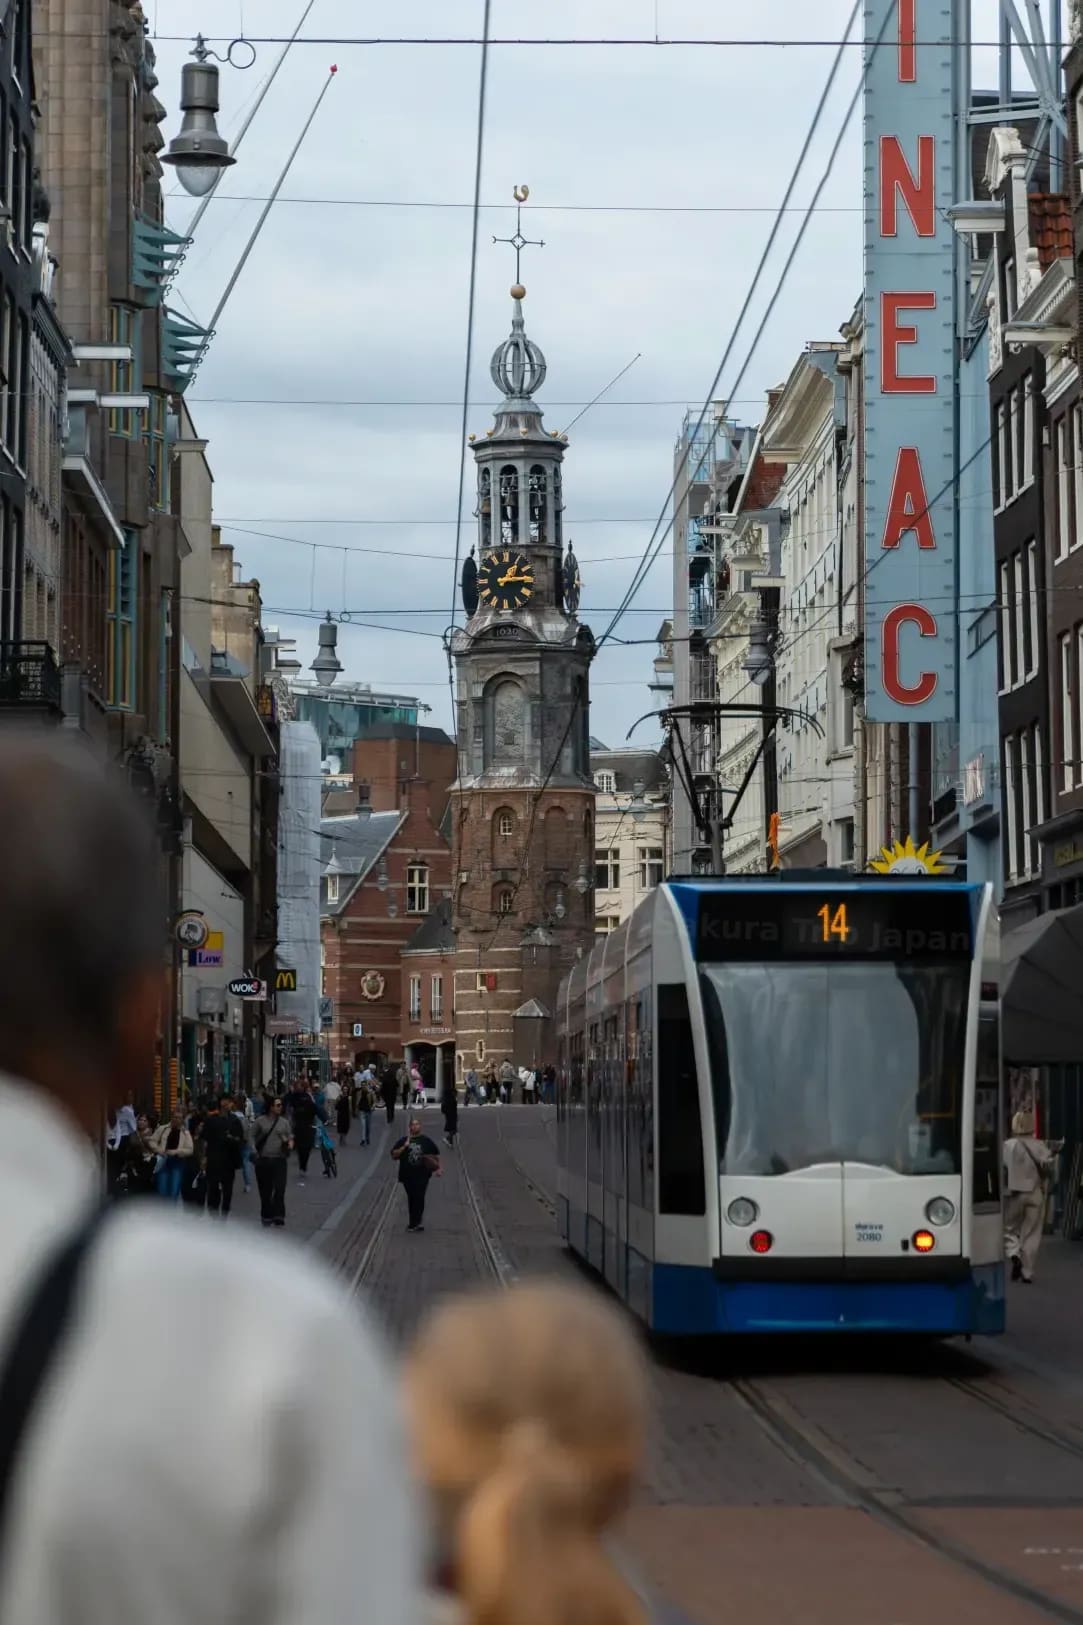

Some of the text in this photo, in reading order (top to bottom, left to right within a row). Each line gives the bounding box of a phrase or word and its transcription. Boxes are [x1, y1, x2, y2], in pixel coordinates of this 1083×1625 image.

[816, 903, 851, 942] 14
[231, 983, 257, 993] WOK
[857, 1232, 882, 1242] 2080
